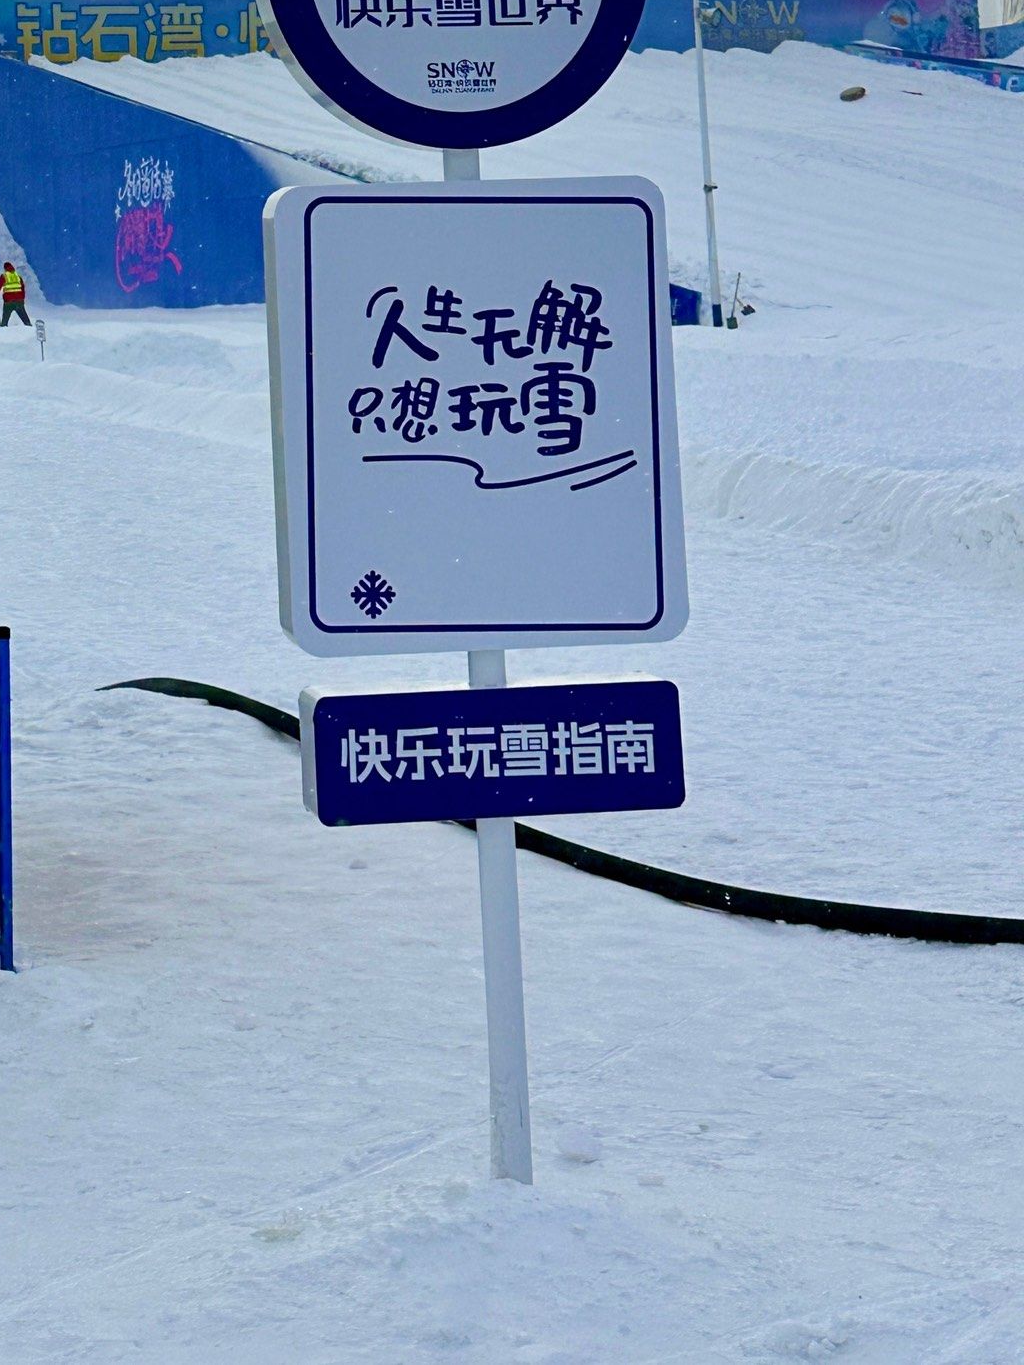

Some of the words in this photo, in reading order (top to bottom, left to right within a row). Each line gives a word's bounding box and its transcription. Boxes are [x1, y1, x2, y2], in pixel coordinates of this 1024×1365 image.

[368, 279, 613, 373] 人生无解
[348, 362, 597, 456] 只想玩雪
[340, 719, 657, 784] 快乐玩雪指南
